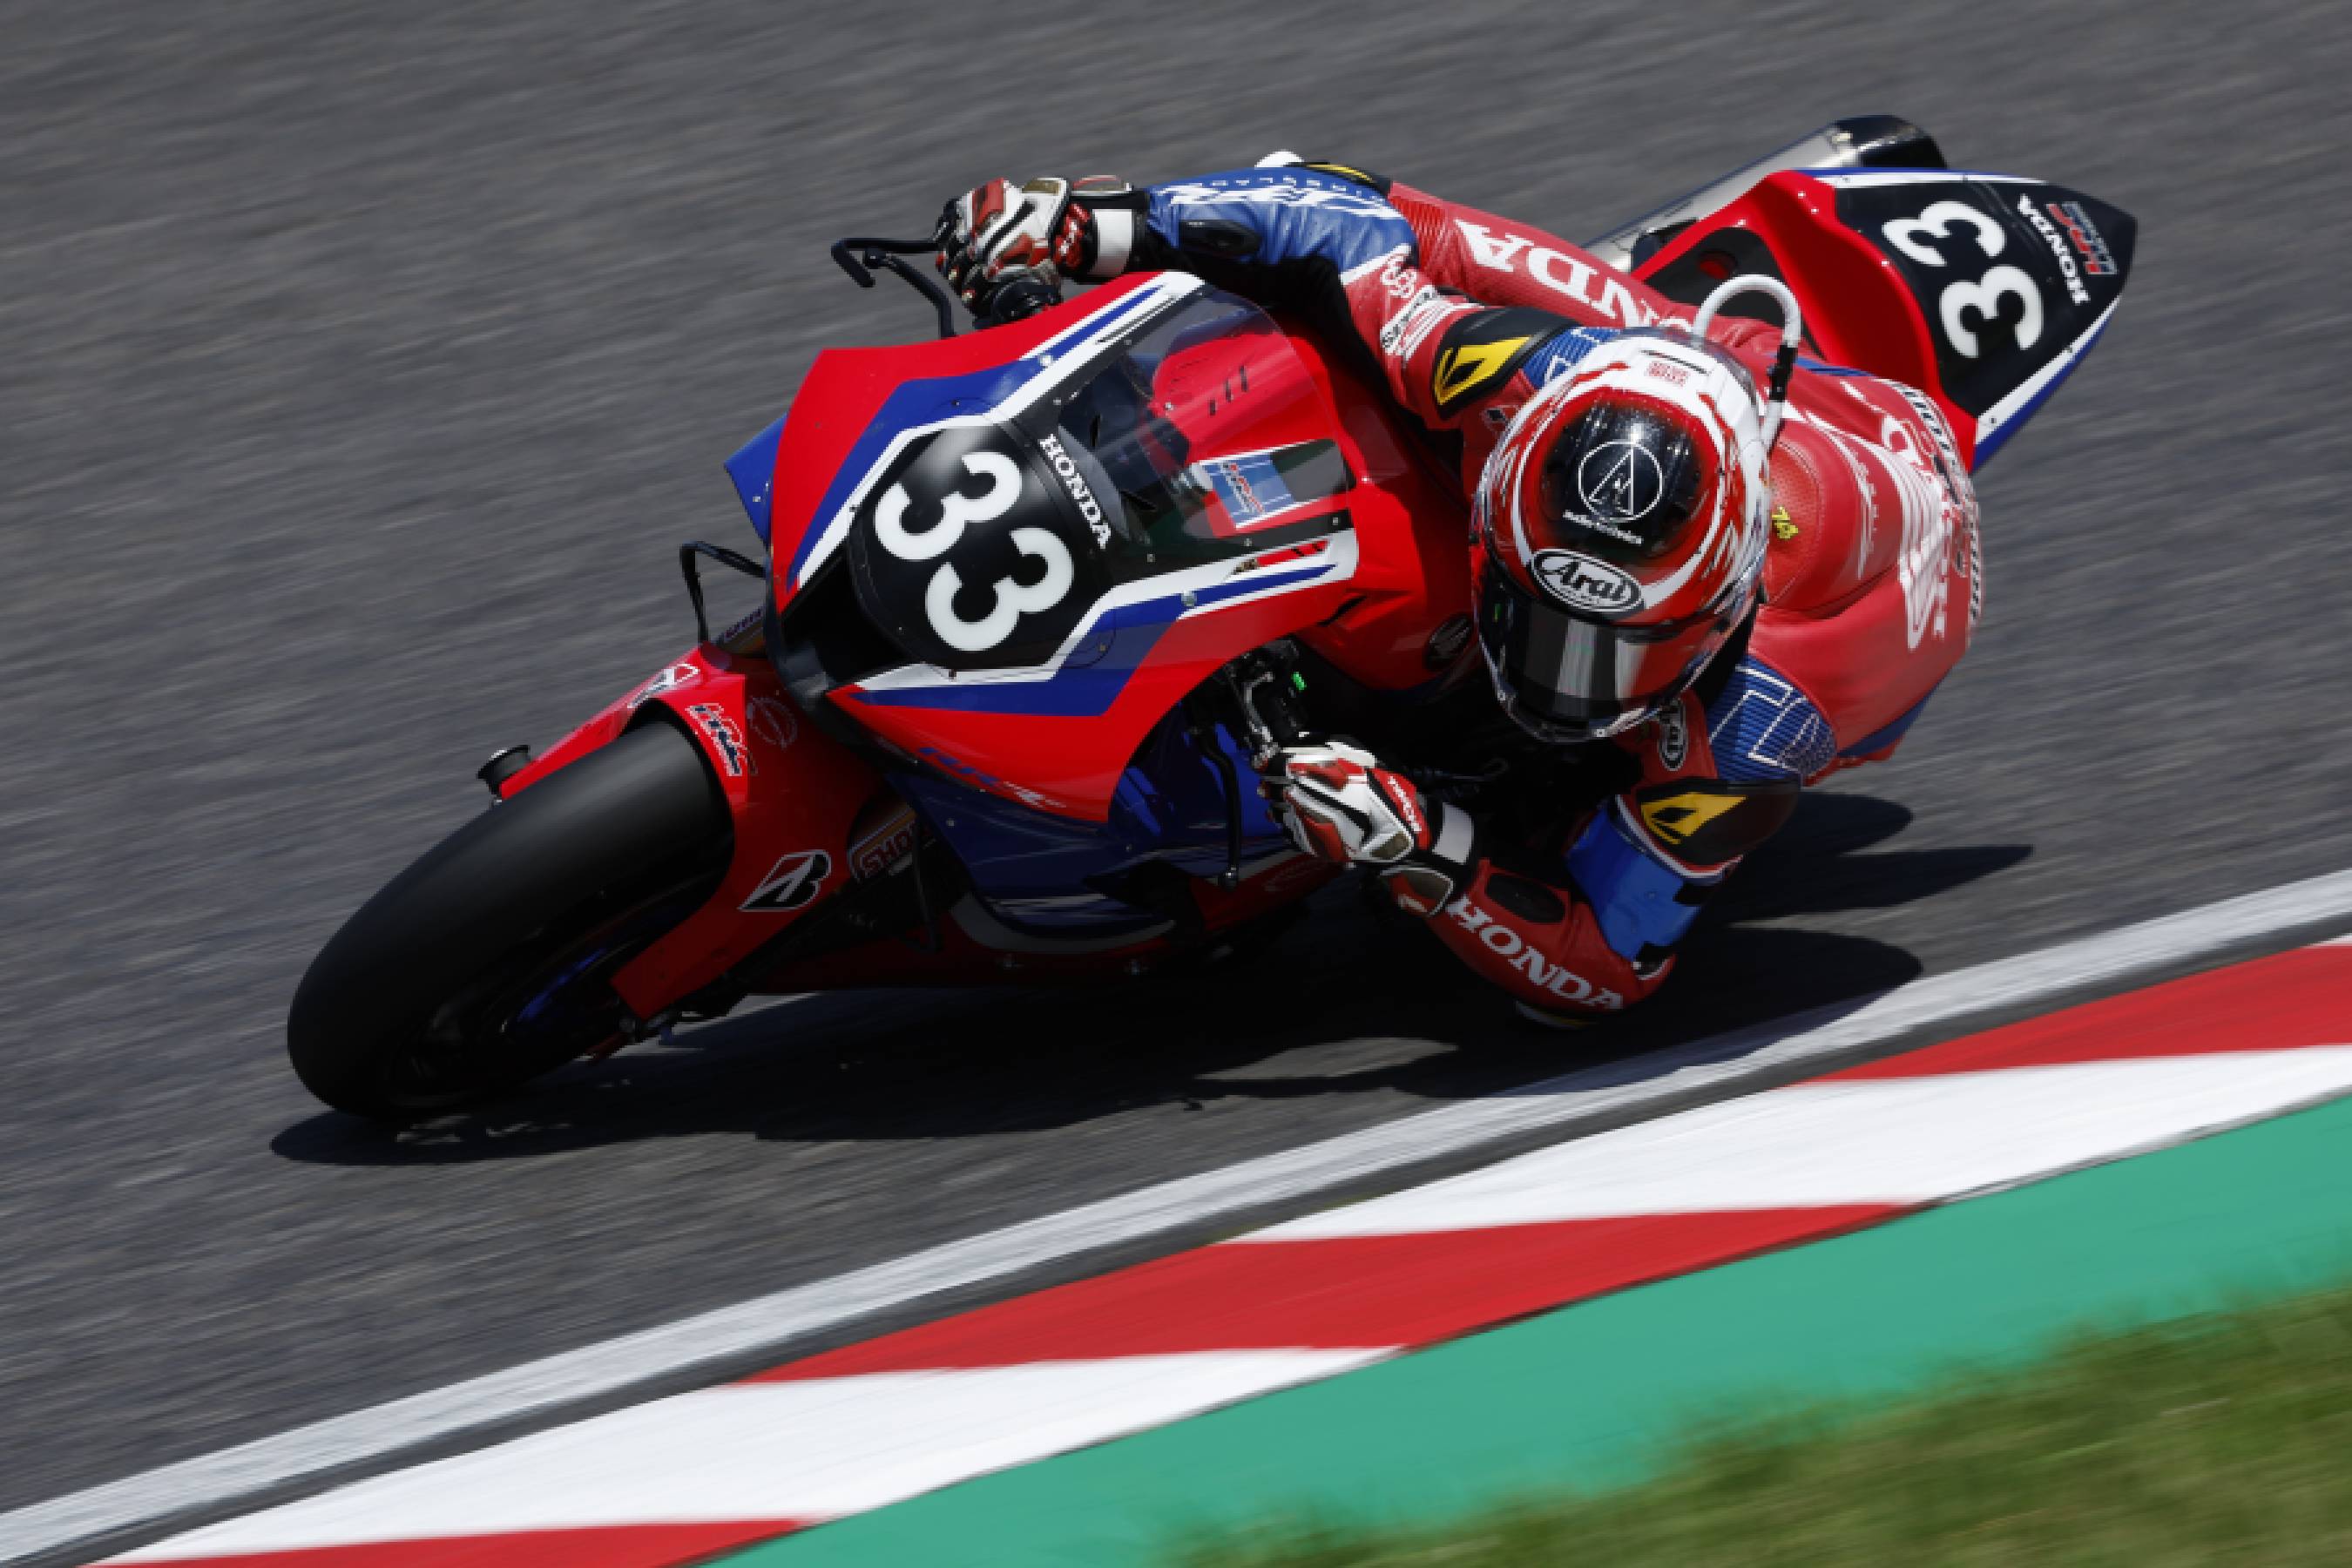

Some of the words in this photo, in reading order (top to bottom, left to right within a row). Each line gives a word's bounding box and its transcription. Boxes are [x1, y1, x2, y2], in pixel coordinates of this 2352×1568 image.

[1455, 219, 1695, 333] NDA
[1882, 201, 2044, 358] 33
[2017, 193, 2091, 304] HONDA
[1039, 434, 1112, 550] HONDA
[875, 451, 1075, 652] 33
[1542, 562, 1625, 601] Arai
[1447, 896, 1623, 1009] HONDA
